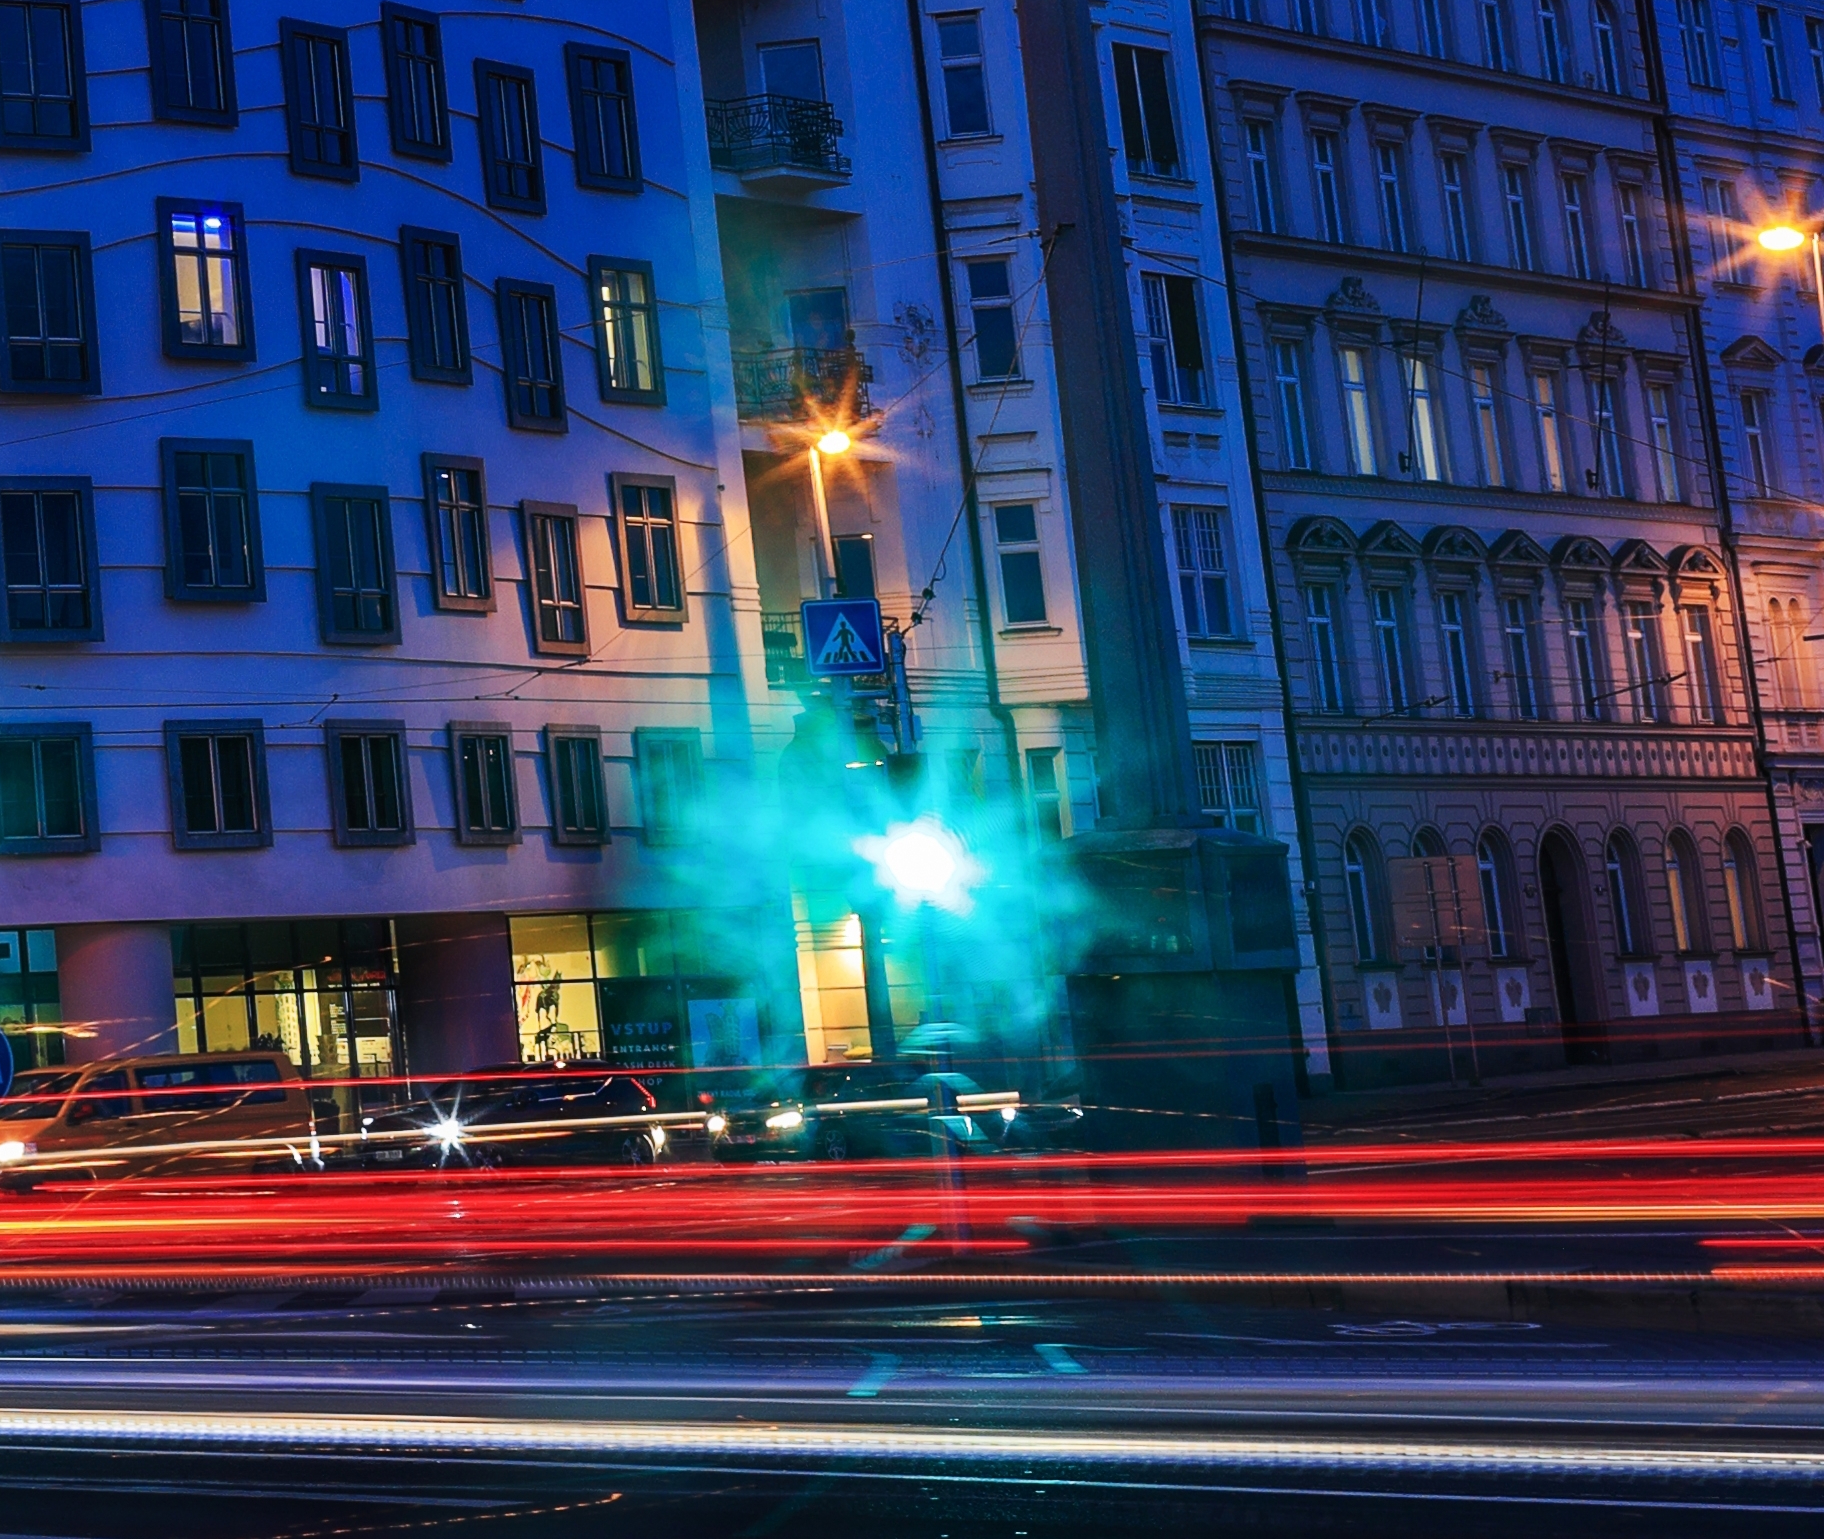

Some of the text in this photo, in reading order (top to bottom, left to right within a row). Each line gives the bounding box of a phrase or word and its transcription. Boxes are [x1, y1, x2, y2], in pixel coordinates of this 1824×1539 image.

[610, 1021, 673, 1037] VSTUP
[612, 1043, 675, 1054] ENTRANCE
[638, 1077, 664, 1087] HOP
